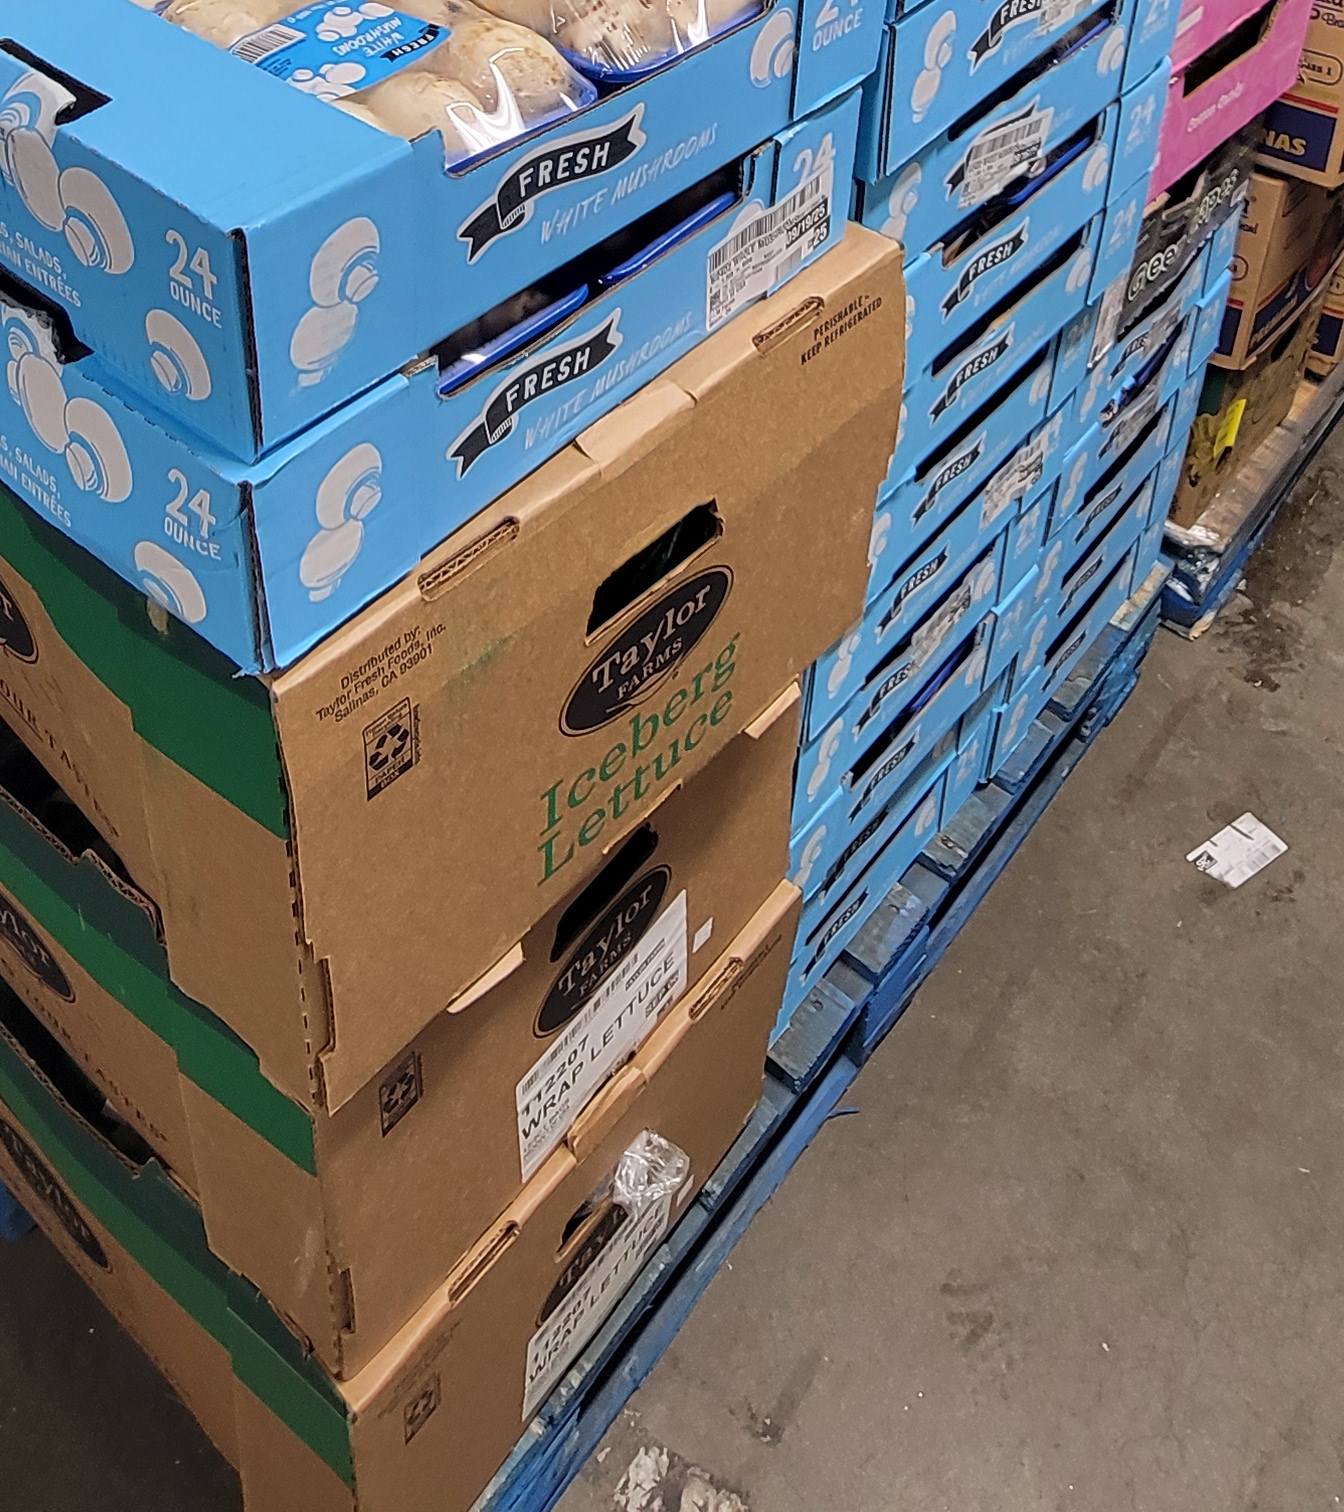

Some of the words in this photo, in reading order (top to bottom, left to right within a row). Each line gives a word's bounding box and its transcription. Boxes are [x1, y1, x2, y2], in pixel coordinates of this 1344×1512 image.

[332, 16, 403, 56] MUSHROOMS
[364, 31, 405, 57] WHITE
[391, 34, 435, 57] FRESH
[812, 8, 863, 52] OUNCE
[517, 141, 611, 198] FRESH
[540, 188, 609, 245] WHITE
[610, 123, 718, 206] MUSHROOMS
[793, 131, 837, 189] 24
[786, 202, 827, 246] 09/19/25
[812, 222, 828, 249] 25
[14, 231, 68, 280] SALADS,
[164, 229, 218, 300] 24
[968, 242, 1015, 282] FRESH
[1128, 243, 1182, 304] Gree
[24, 263, 82, 308] ENTRÉES
[170, 280, 223, 329] OUNCE
[800, 339, 823, 366] KEEP
[823, 296, 883, 349] REFRIGERATED
[505, 345, 592, 413] FRESH
[524, 390, 591, 451] WHITE
[593, 312, 693, 399] MUSHROOMS
[956, 348, 999, 388] FRESH
[14, 444, 63, 499] SALADS,
[935, 451, 973, 492] FRESH
[20, 474, 73, 528] ENTRÉES
[164, 467, 217, 540] 24
[163, 517, 223, 561] OUNCE
[900, 558, 940, 599] FRESH
[340, 636, 403, 690] Distributed
[403, 624, 422, 644] by:
[591, 584, 711, 695] Taylor
[315, 689, 353, 722] Taylor
[354, 665, 387, 696] Fresh
[387, 640, 426, 668] Foods,
[425, 623, 448, 642] Inc.
[334, 688, 380, 724] Salinas,
[381, 670, 399, 690] CA
[399, 643, 434, 676] 93901
[616, 637, 684, 702] FARMS
[877, 662, 912, 699] FRES
[539, 631, 742, 838] Iceberg
[537, 689, 734, 887] Lettuce
[869, 746, 907, 787] FRESH
[557, 883, 654, 998] Taylor
[823, 901, 860, 946] FRESH
[579, 931, 634, 998] FARMS
[521, 1061, 586, 1140] WRAP
[590, 951, 676, 1065] LETTUCE
[521, 1033, 591, 1118] 112207
[528, 1307, 586, 1384] WRAP
[588, 1200, 662, 1309] LETTUCE
[532, 1285, 593, 1364] 112207
